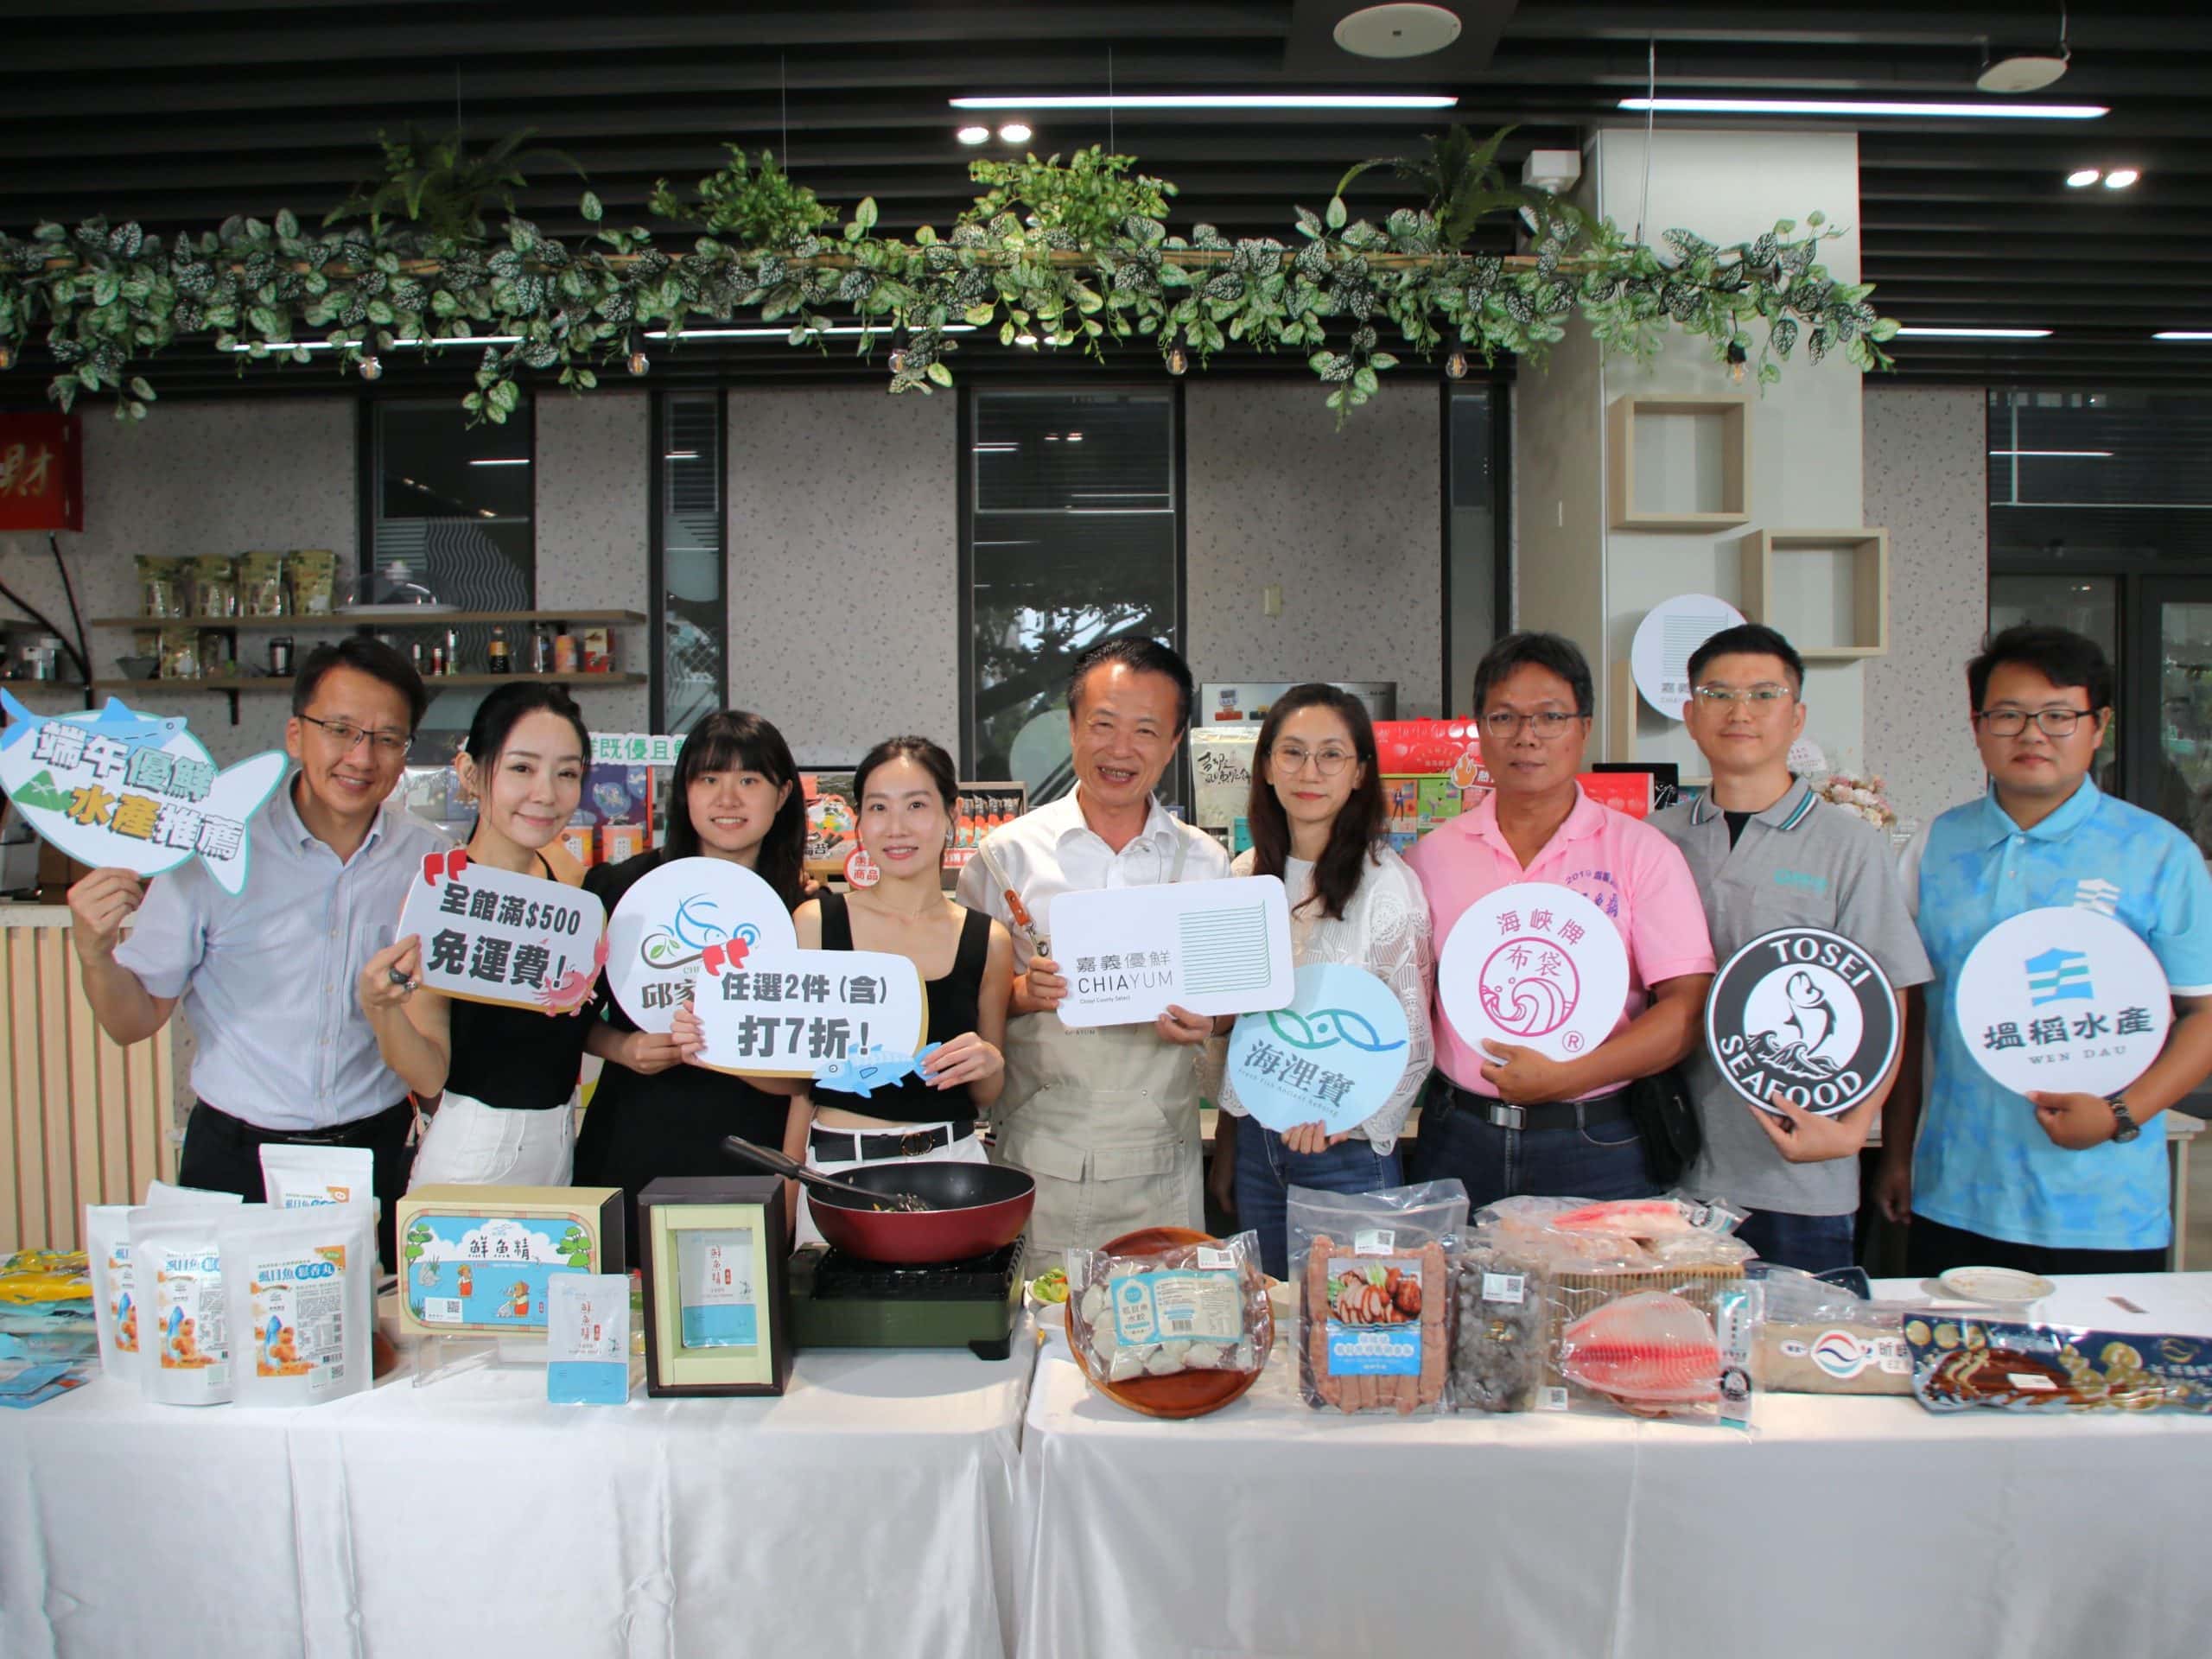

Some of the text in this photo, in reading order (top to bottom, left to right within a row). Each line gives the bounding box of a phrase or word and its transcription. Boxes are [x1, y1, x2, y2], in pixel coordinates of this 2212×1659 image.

[32, 721, 215, 803] 端午優鮮
[66, 784, 245, 861] 水產推薦
[439, 882, 582, 935] 全館滿$500
[1496, 908, 1586, 946] 海峽牌
[1077, 950, 1171, 973] 嘉義優鮮
[1077, 969, 1173, 995] CHIAYUM
[1505, 944, 1562, 977] 布袋
[1770, 937, 1873, 988] TOSEI
[1984, 1006, 2155, 1051] 塭稻水產
[1243, 1039, 1356, 1108] 海浬寶
[1720, 1034, 1863, 1109] SEAFOOD
[2029, 1046, 2127, 1065] WEN DAU
[468, 1235, 531, 1261] 鮮魚精
